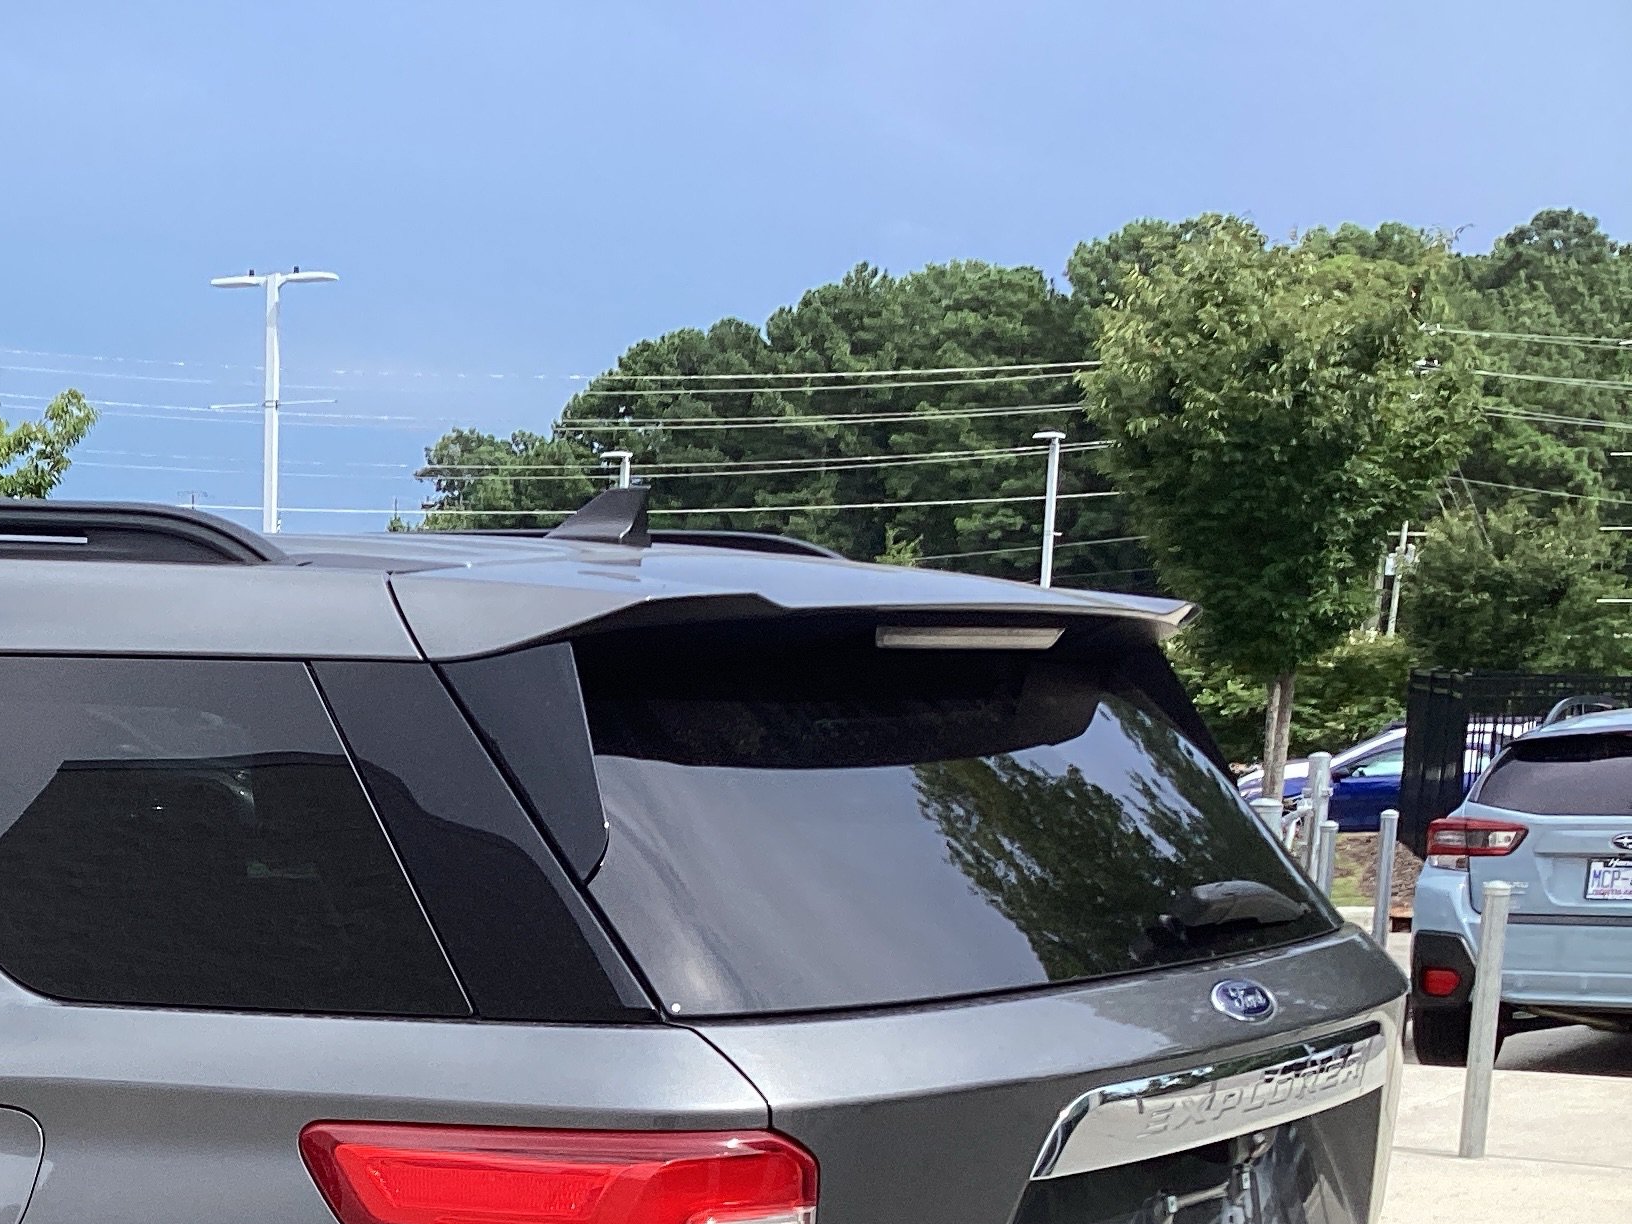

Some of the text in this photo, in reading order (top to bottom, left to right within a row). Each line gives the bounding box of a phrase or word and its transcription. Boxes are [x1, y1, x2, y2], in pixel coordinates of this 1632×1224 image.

[1591, 869, 1632, 889] MCP-
[1227, 986, 1267, 1009] Ford
[1136, 1053, 1365, 1139] EXPLORER
